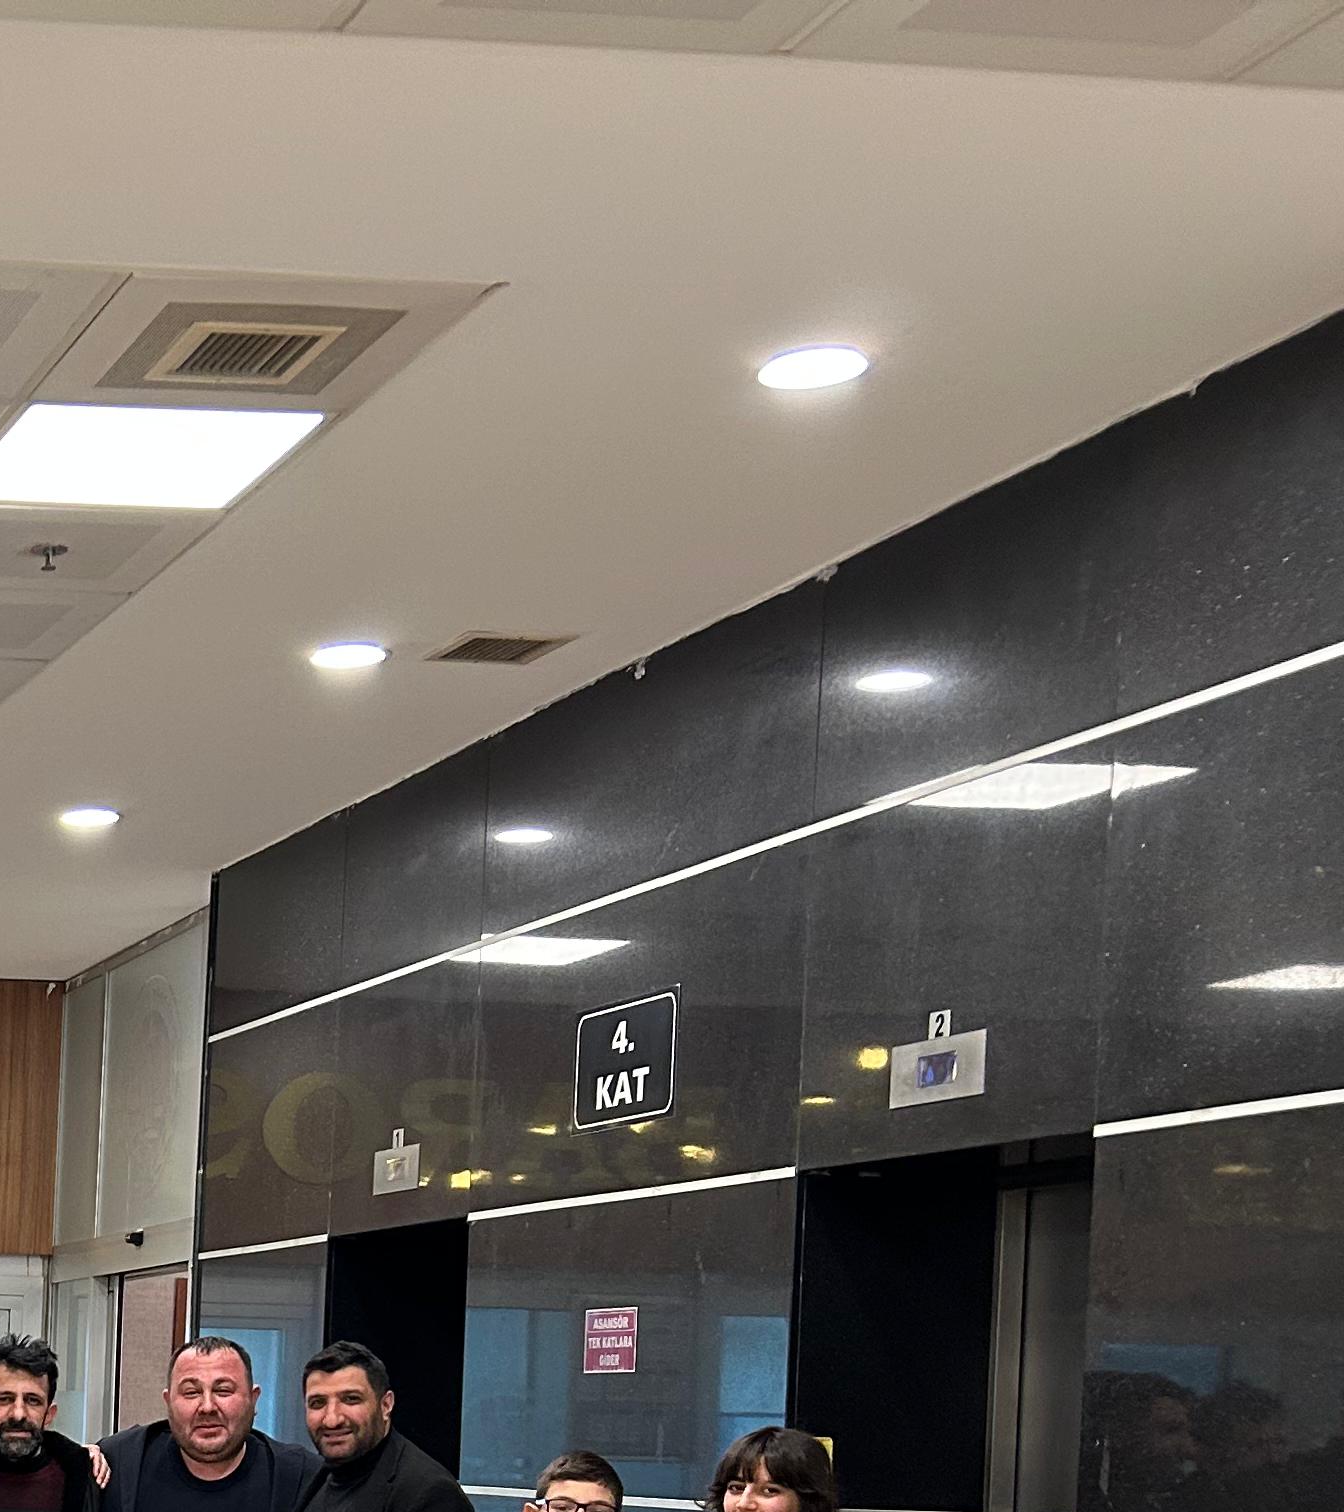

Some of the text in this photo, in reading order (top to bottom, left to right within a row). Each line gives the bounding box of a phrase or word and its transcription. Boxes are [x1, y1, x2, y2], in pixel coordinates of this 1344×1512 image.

[611, 1020, 635, 1054] 4.
[934, 1013, 946, 1039] 2
[595, 1065, 650, 1111] KAT
[593, 1314, 629, 1330] ASANSÖR
[588, 1335, 633, 1349] TEK KATLARA
